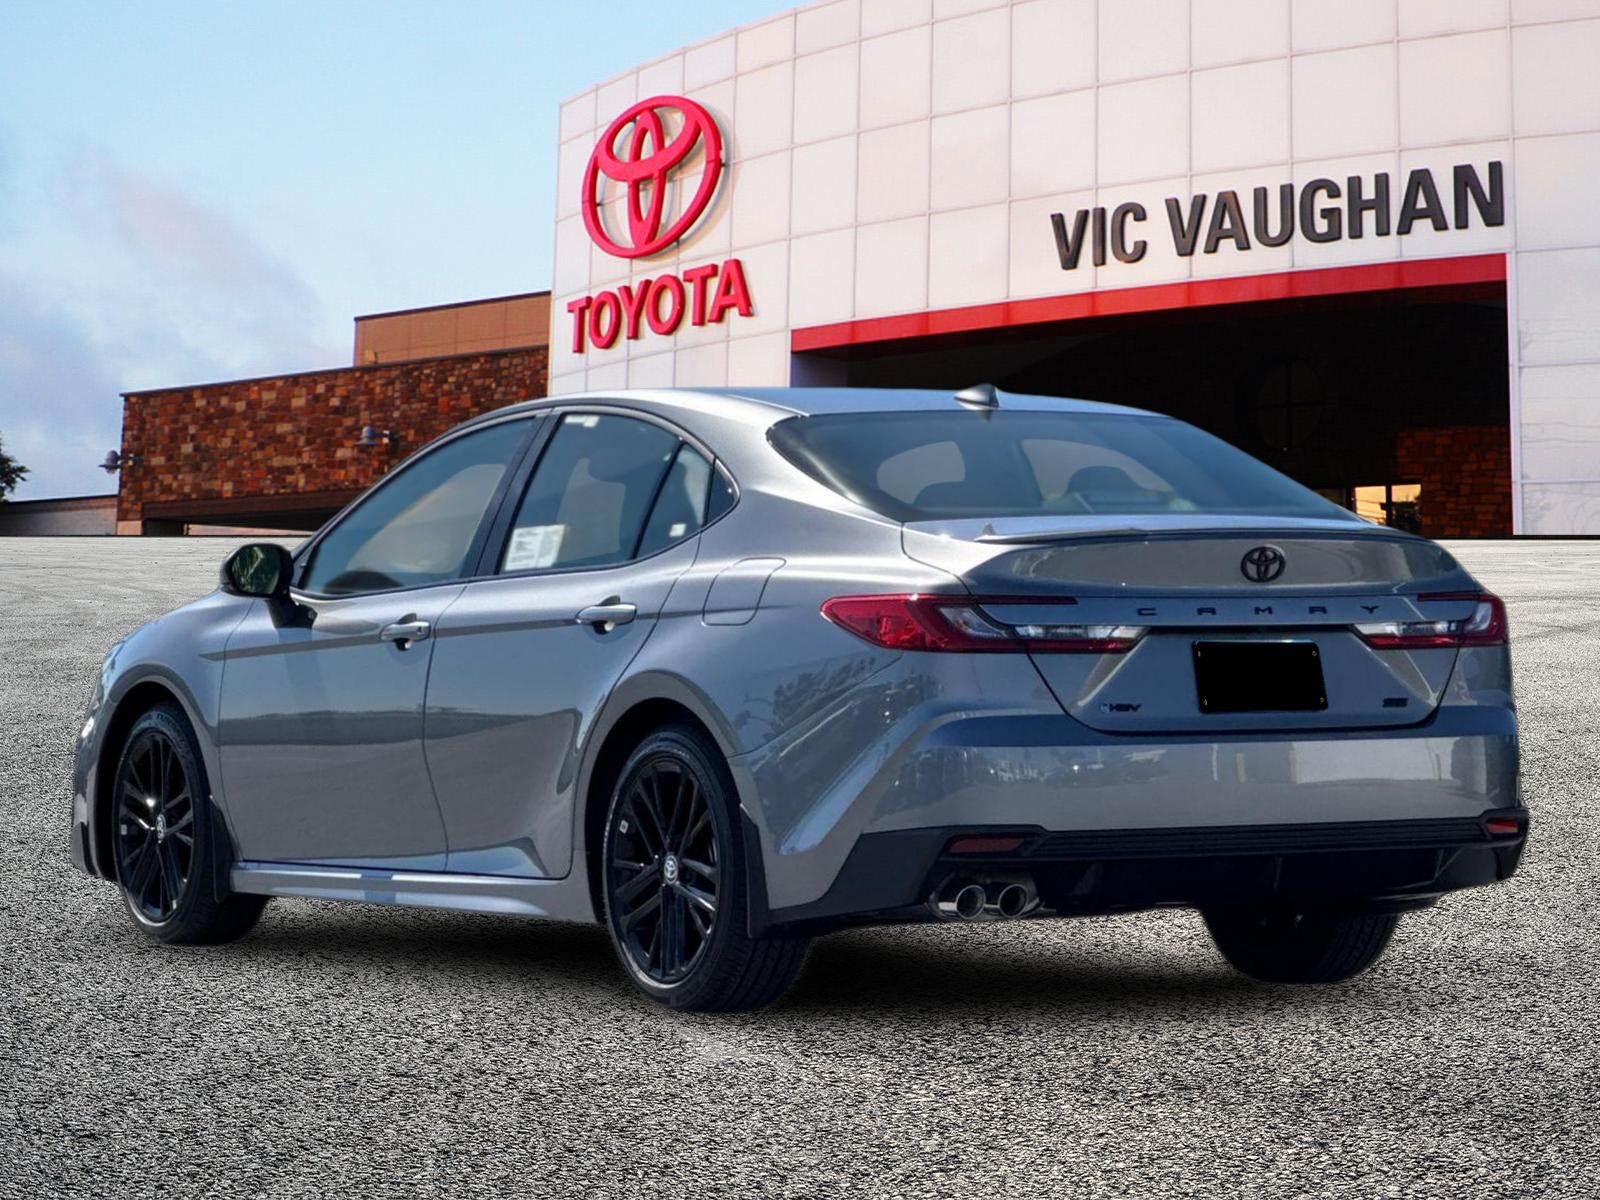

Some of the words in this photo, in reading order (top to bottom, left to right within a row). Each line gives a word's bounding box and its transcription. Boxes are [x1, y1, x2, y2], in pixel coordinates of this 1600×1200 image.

[1050, 201, 1148, 271] VIC
[1164, 160, 1505, 257] VAUGHAN
[567, 258, 754, 354] TOYOTA
[1137, 606, 1380, 617] CAMRY
